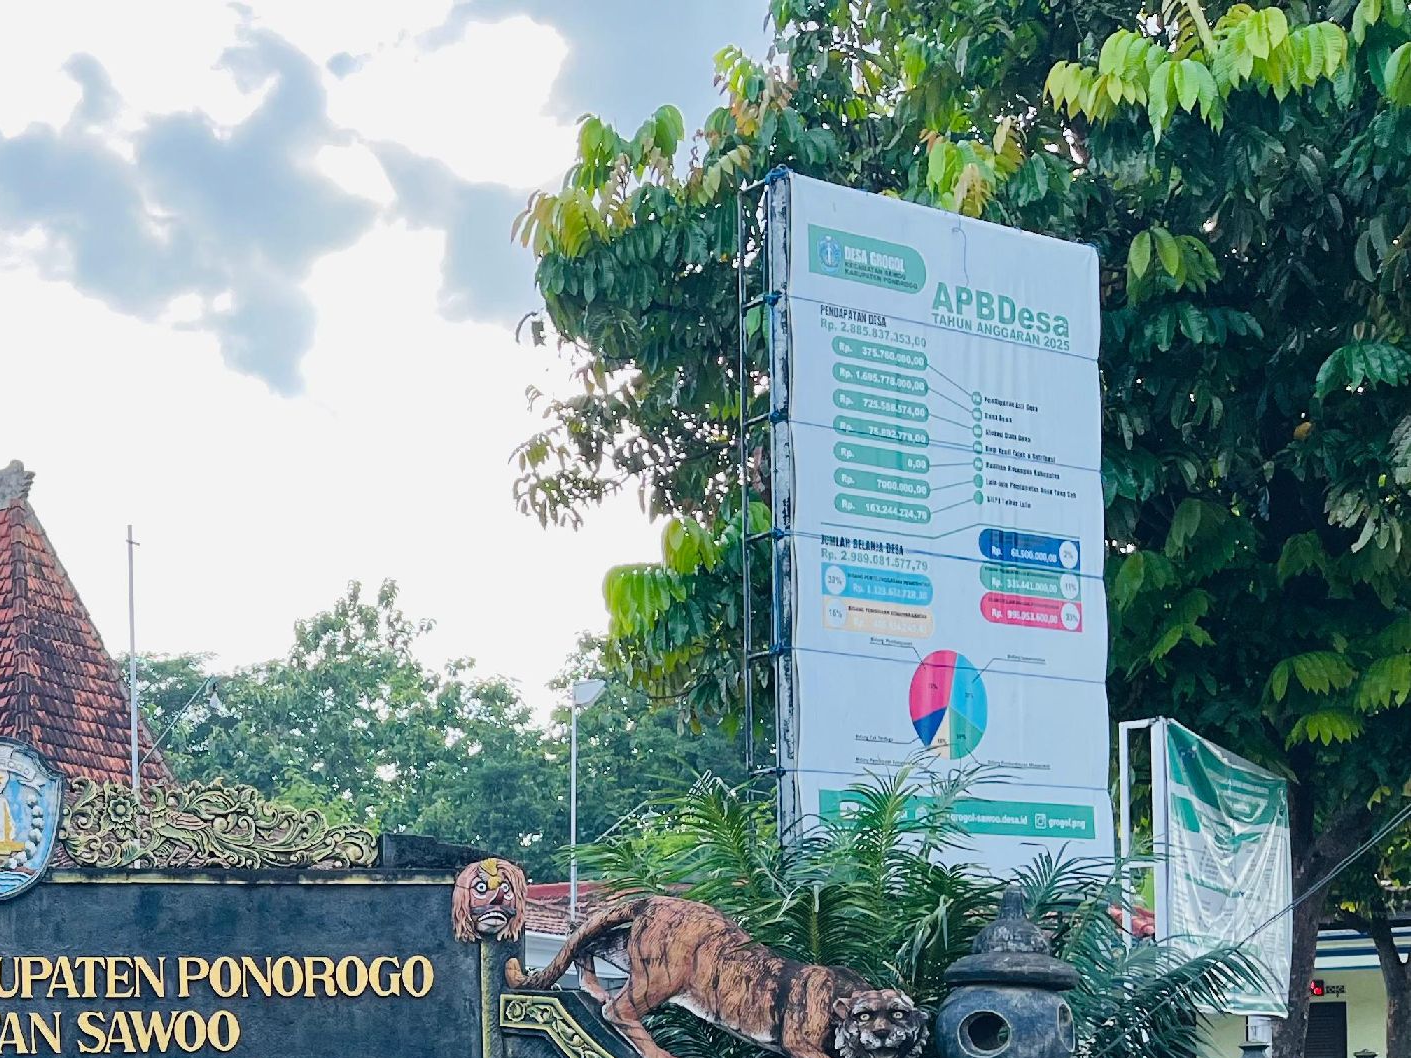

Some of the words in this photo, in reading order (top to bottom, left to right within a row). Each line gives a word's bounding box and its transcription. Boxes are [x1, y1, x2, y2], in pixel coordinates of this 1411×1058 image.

[820, 304, 867, 323] PENDAPATAN
[868, 314, 887, 327] DESA
[932, 281, 1069, 338] APBDesa
[931, 313, 972, 331] TAHUN
[977, 322, 1041, 346] ANGGARAN
[1044, 336, 1069, 351] 2025
[177, 954, 435, 999] PONOROGO
[76, 1009, 241, 1053] SAWOO
